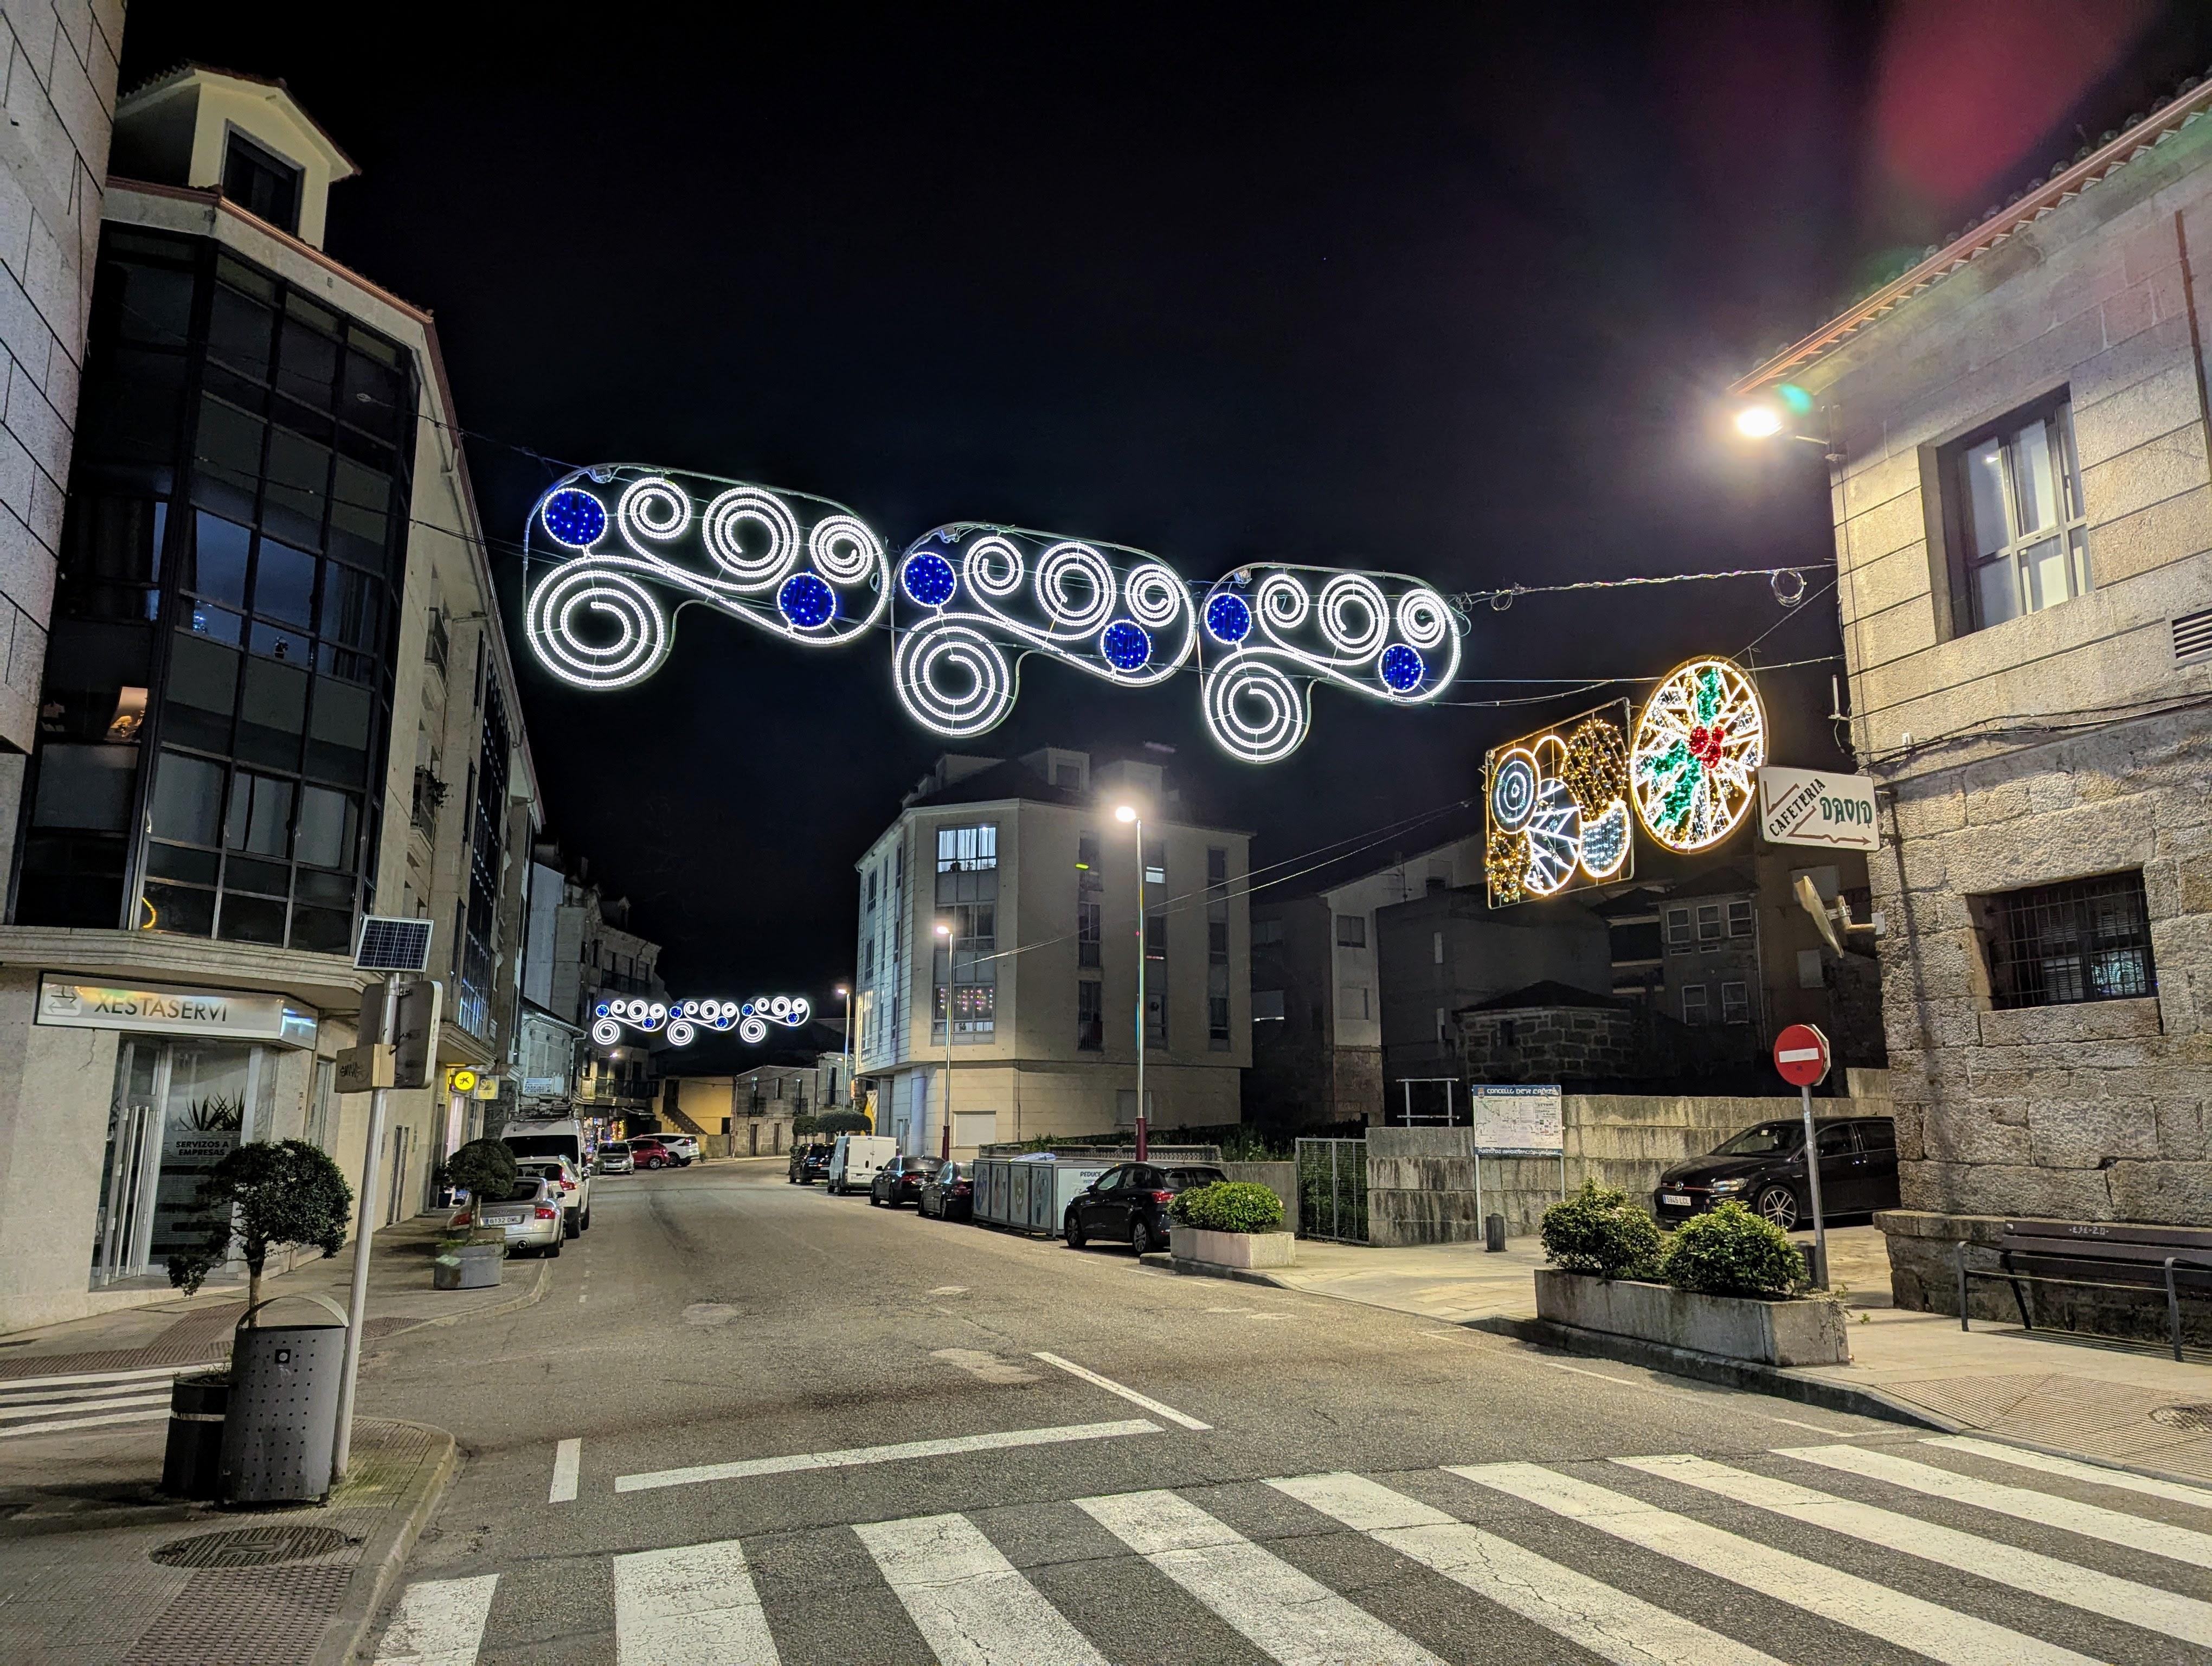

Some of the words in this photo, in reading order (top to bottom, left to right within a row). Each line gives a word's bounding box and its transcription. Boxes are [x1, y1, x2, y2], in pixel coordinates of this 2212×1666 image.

[1769, 778, 1826, 836] CAFETERIA
[1819, 797, 1873, 829] DAVID
[94, 993, 226, 1022] XESTASERVI
